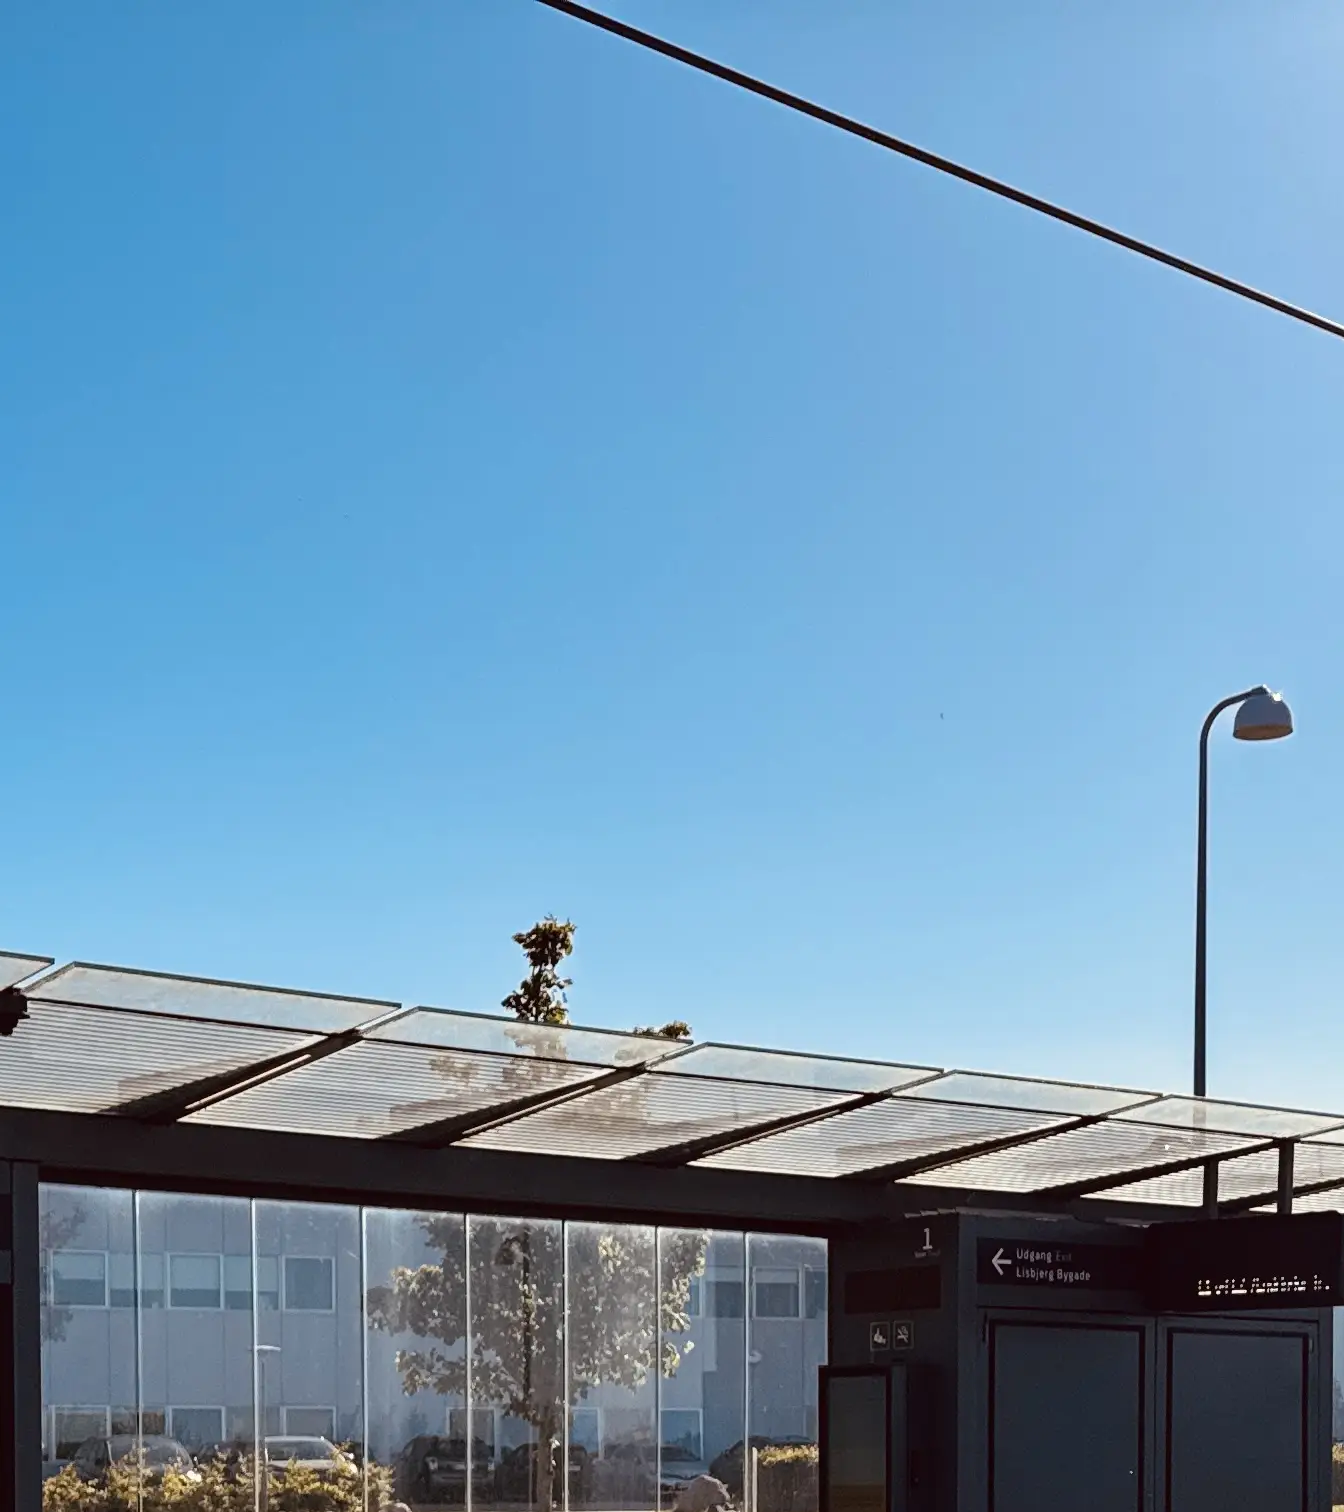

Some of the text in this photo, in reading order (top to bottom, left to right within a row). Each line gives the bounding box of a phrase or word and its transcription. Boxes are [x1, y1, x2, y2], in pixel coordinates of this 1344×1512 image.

[922, 1227, 933, 1250] 1
[1016, 1247, 1052, 1264] Udgang
[1016, 1265, 1091, 1283] Lisbjerg Bygade
